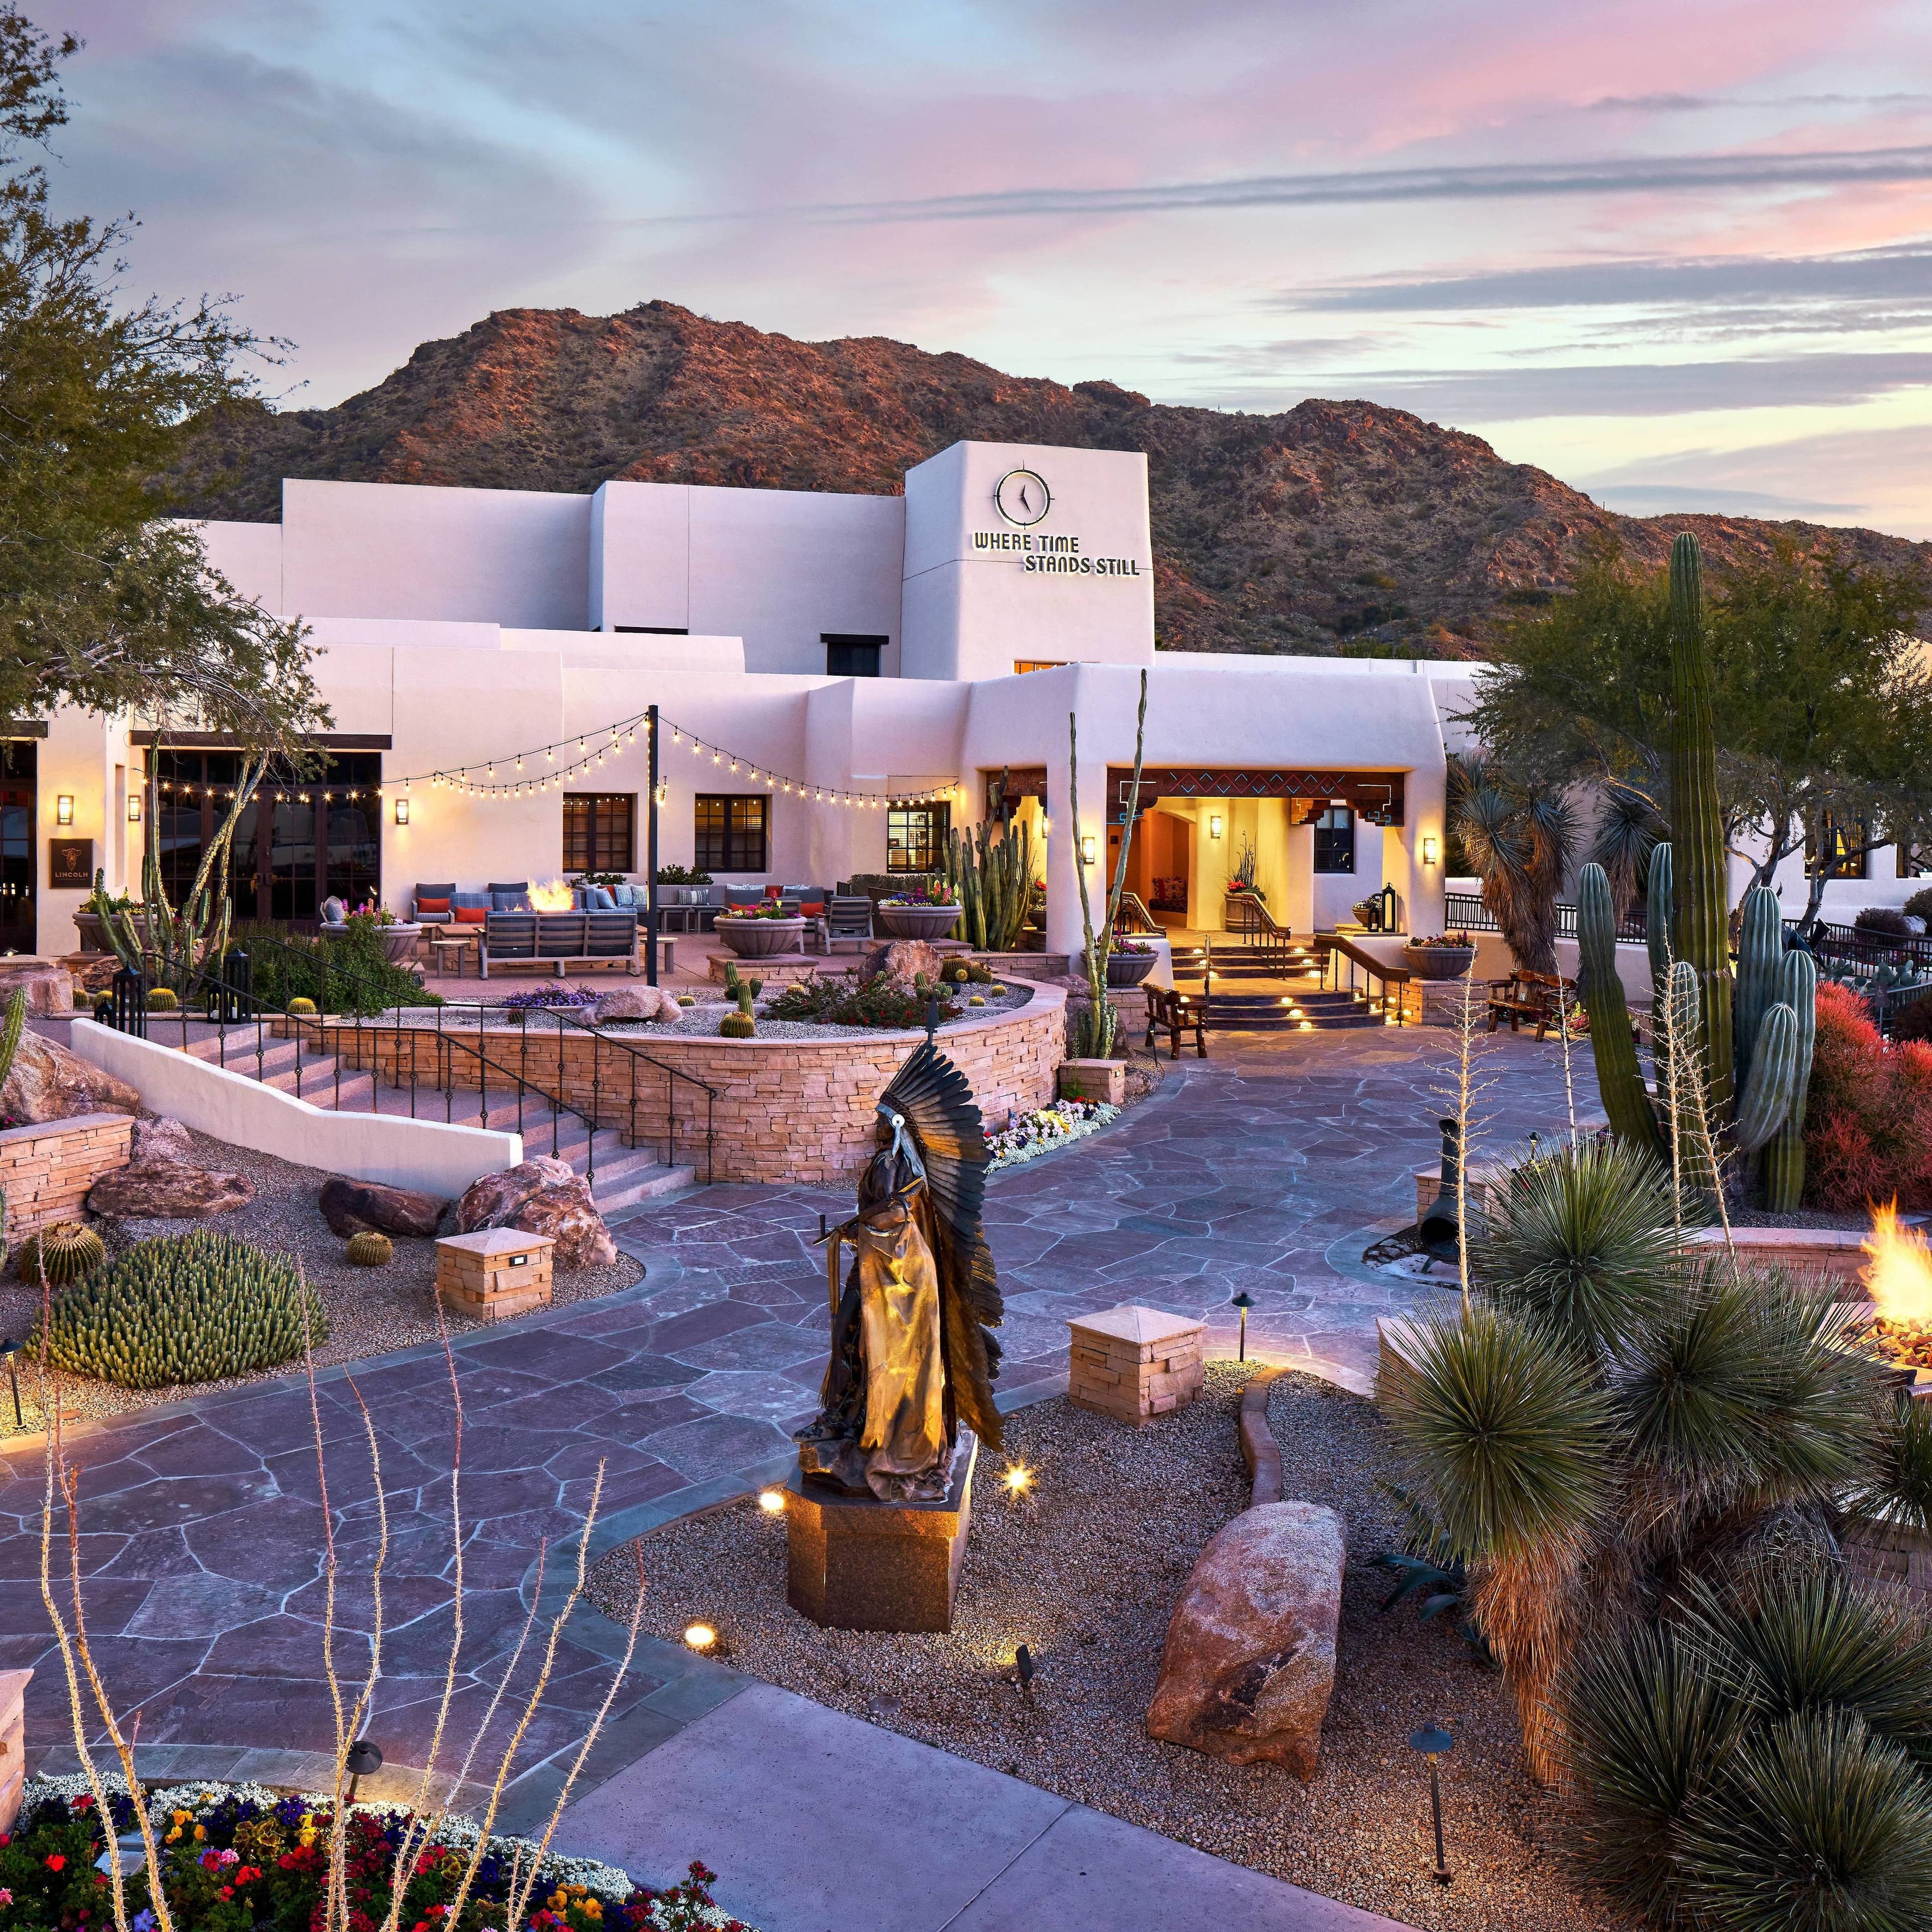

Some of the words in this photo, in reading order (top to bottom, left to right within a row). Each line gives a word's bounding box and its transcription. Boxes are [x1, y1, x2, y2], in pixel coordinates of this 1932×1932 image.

[975, 532, 1031, 551] WHERE
[1038, 535, 1079, 553] TIME
[1025, 555, 1090, 574] STANDS
[1096, 558, 1140, 576] STILL
